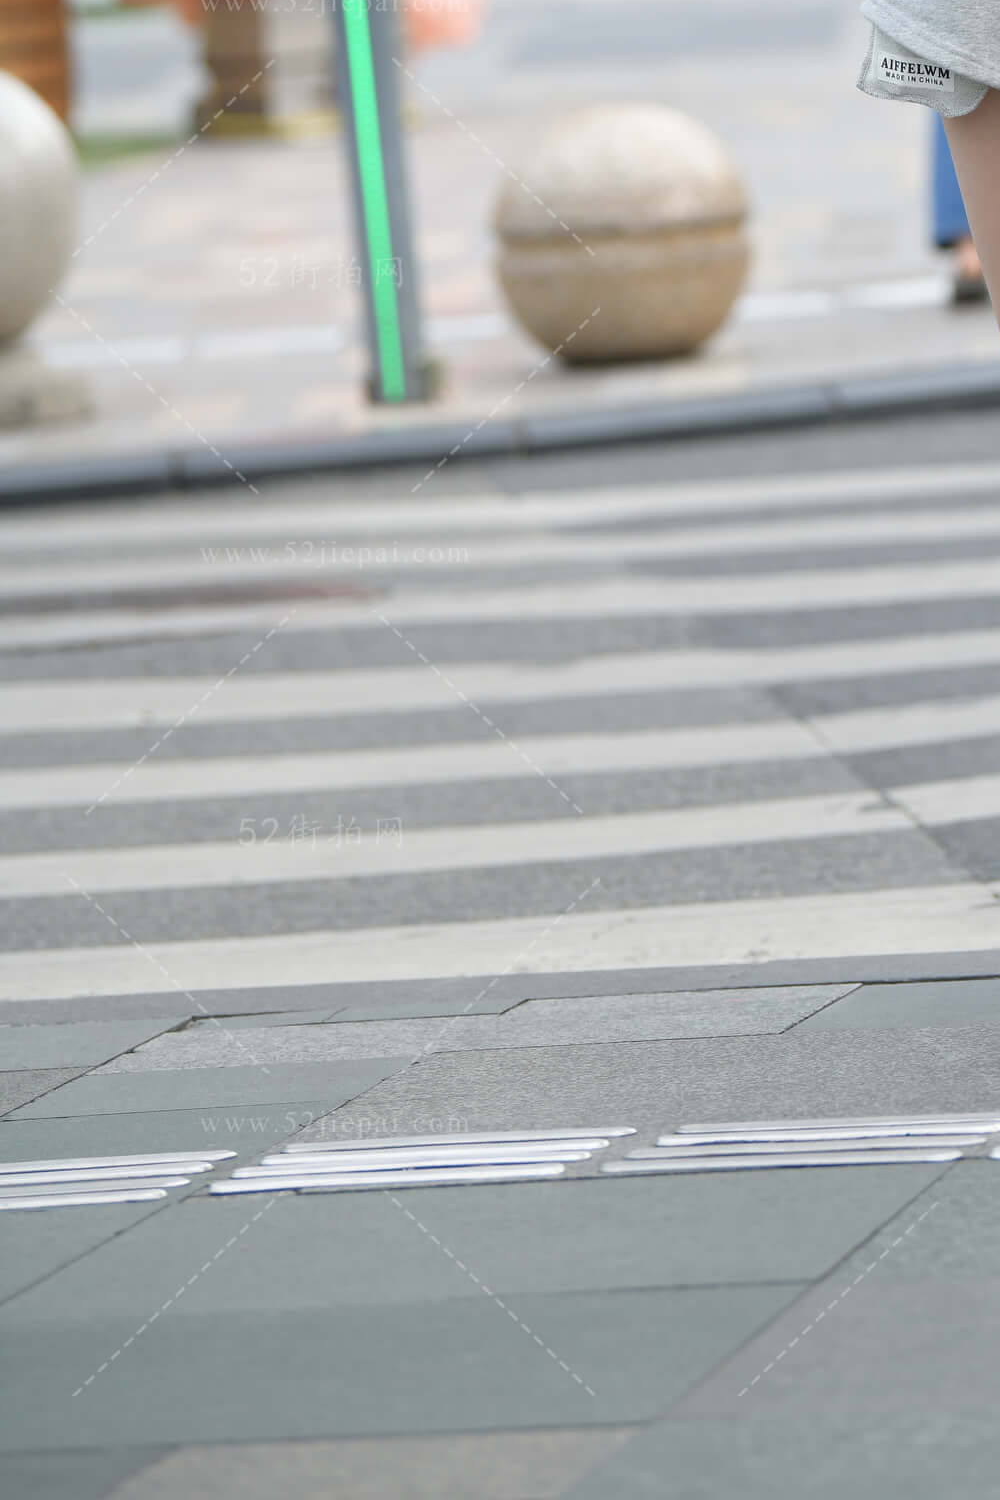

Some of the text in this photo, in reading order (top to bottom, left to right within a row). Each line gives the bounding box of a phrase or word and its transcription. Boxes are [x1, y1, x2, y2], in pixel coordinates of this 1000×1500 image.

[881, 57, 951, 79] AIFFELWM
[885, 71, 905, 81] MADE
[919, 76, 944, 86] CHINA
